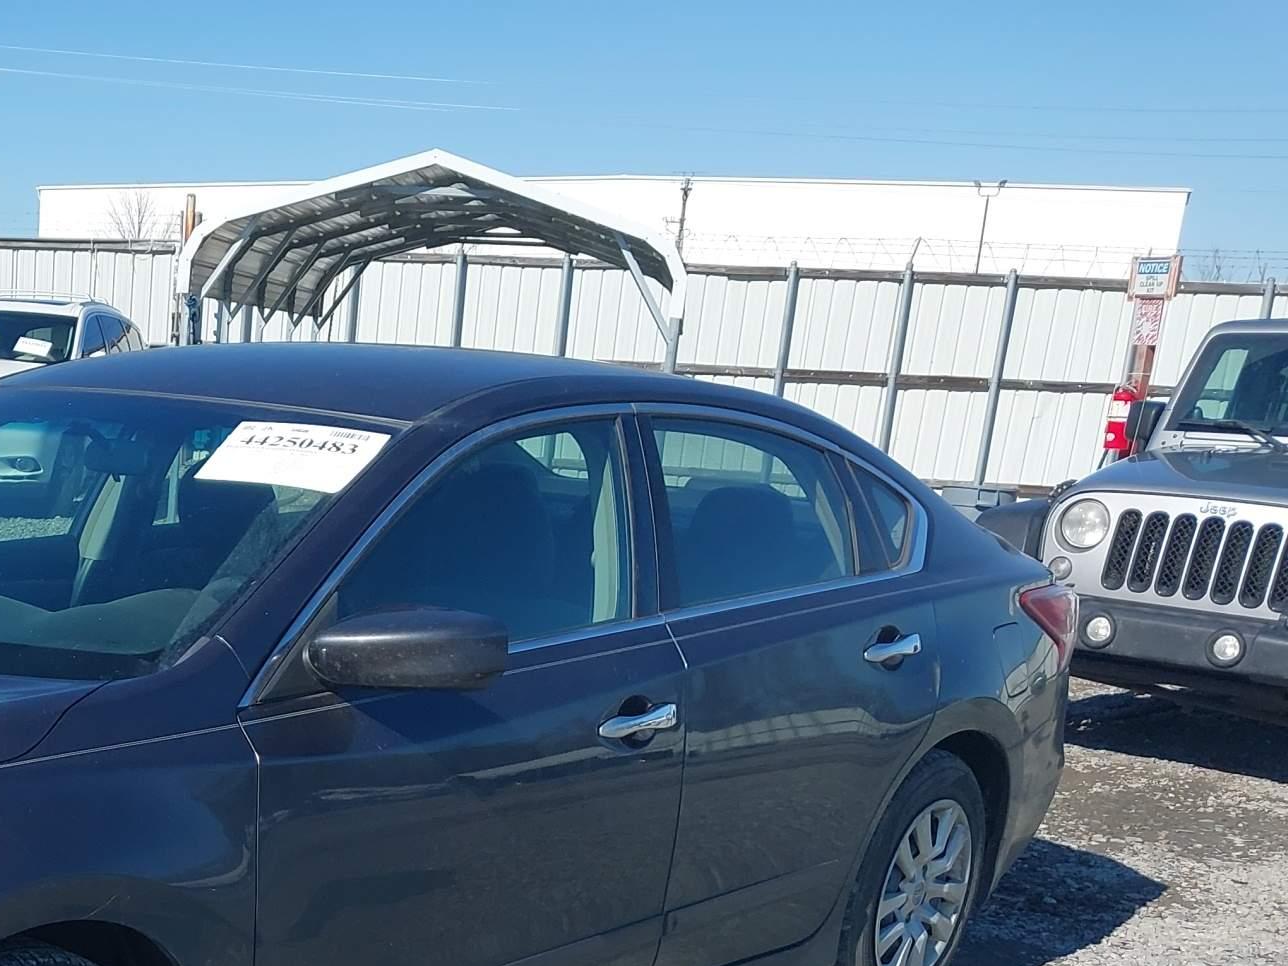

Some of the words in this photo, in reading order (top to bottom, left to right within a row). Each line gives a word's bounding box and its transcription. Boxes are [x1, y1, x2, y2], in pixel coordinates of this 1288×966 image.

[1138, 263, 1169, 273] NOTICE
[240, 434, 359, 455] 44250483
[1199, 502, 1238, 518] Jeep
